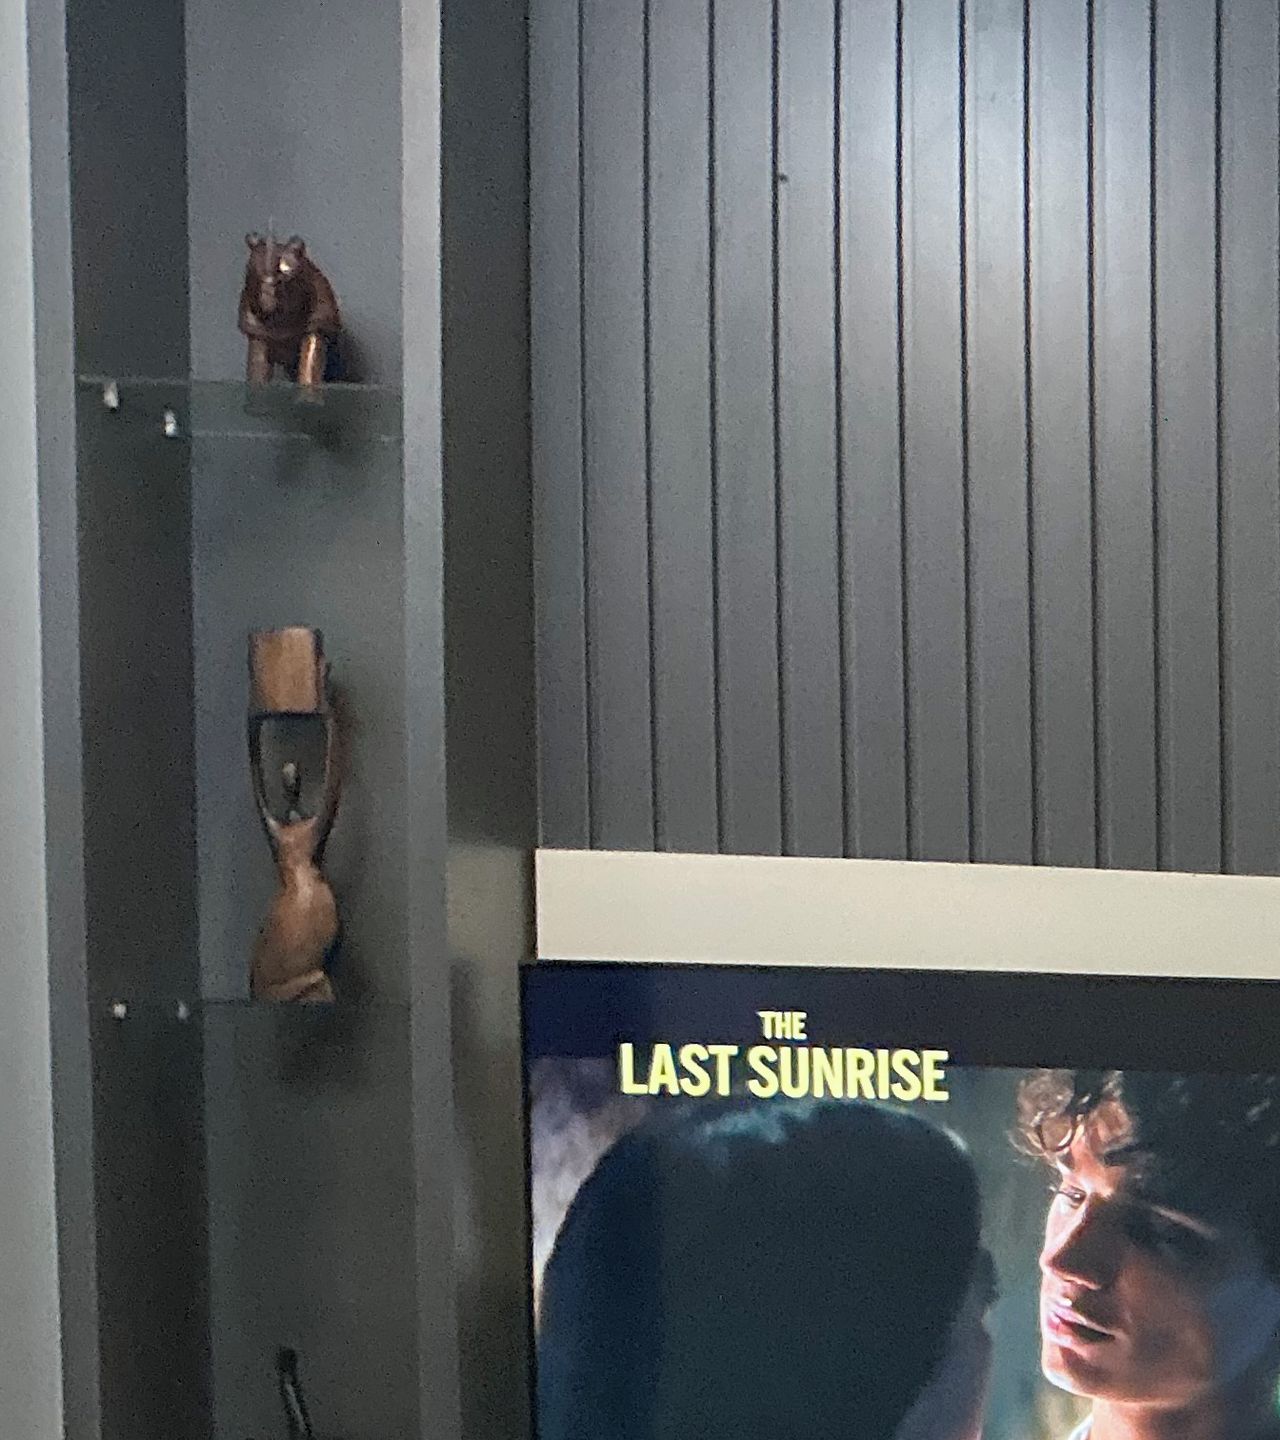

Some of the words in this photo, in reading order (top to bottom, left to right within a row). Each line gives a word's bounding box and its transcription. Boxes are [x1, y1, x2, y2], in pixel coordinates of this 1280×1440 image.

[756, 1010, 808, 1041] THE
[619, 1042, 739, 1097] LAST
[746, 1045, 950, 1101] SUNRISE
